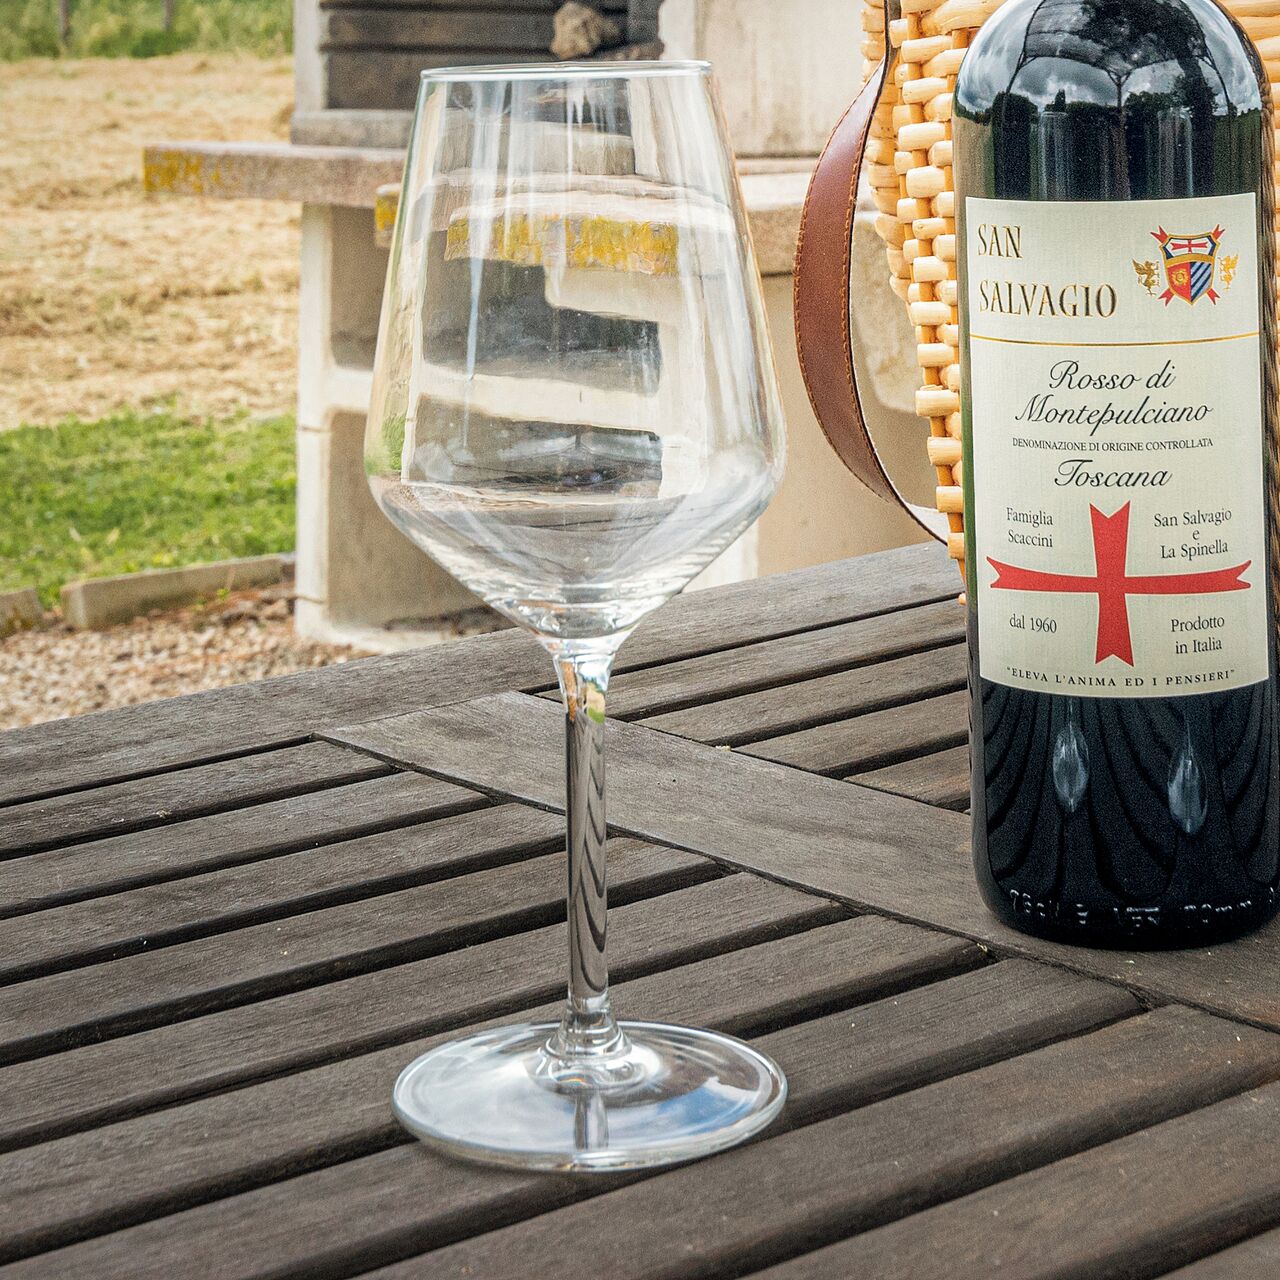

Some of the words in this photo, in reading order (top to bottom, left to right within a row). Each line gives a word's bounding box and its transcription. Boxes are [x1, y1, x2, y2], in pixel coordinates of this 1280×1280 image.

[978, 223, 1023, 259] SAN
[979, 279, 1117, 318] SALVAGIO
[1049, 359, 1141, 390] Rosso
[1146, 359, 1176, 389] di
[1015, 393, 1214, 437] Montepulciano
[1012, 437, 1087, 451] DENOMINAZIONE
[1089, 443, 1100, 452] DI
[1101, 441, 1144, 452] ORIGINE
[1145, 437, 1214, 451] CONTROLLATA
[1054, 459, 1173, 487] Toscana
[1006, 507, 1053, 528] Famiglia
[1153, 513, 1178, 527] San
[1182, 507, 1232, 526] Salvagio
[1008, 529, 1053, 548] Scaccini
[1192, 529, 1200, 540] e
[1160, 545, 1176, 559] La
[1181, 539, 1229, 560] Spinella
[1009, 613, 1025, 629] dal
[1030, 617, 1057, 633] 1960
[1171, 616, 1225, 632] Prodotto
[1175, 641, 1188, 654] in
[1193, 637, 1222, 653] Italia
[1055, 674, 1117, 687] L'ANIMA
[1125, 677, 1144, 687] ED
[1152, 677, 1158, 686] I
